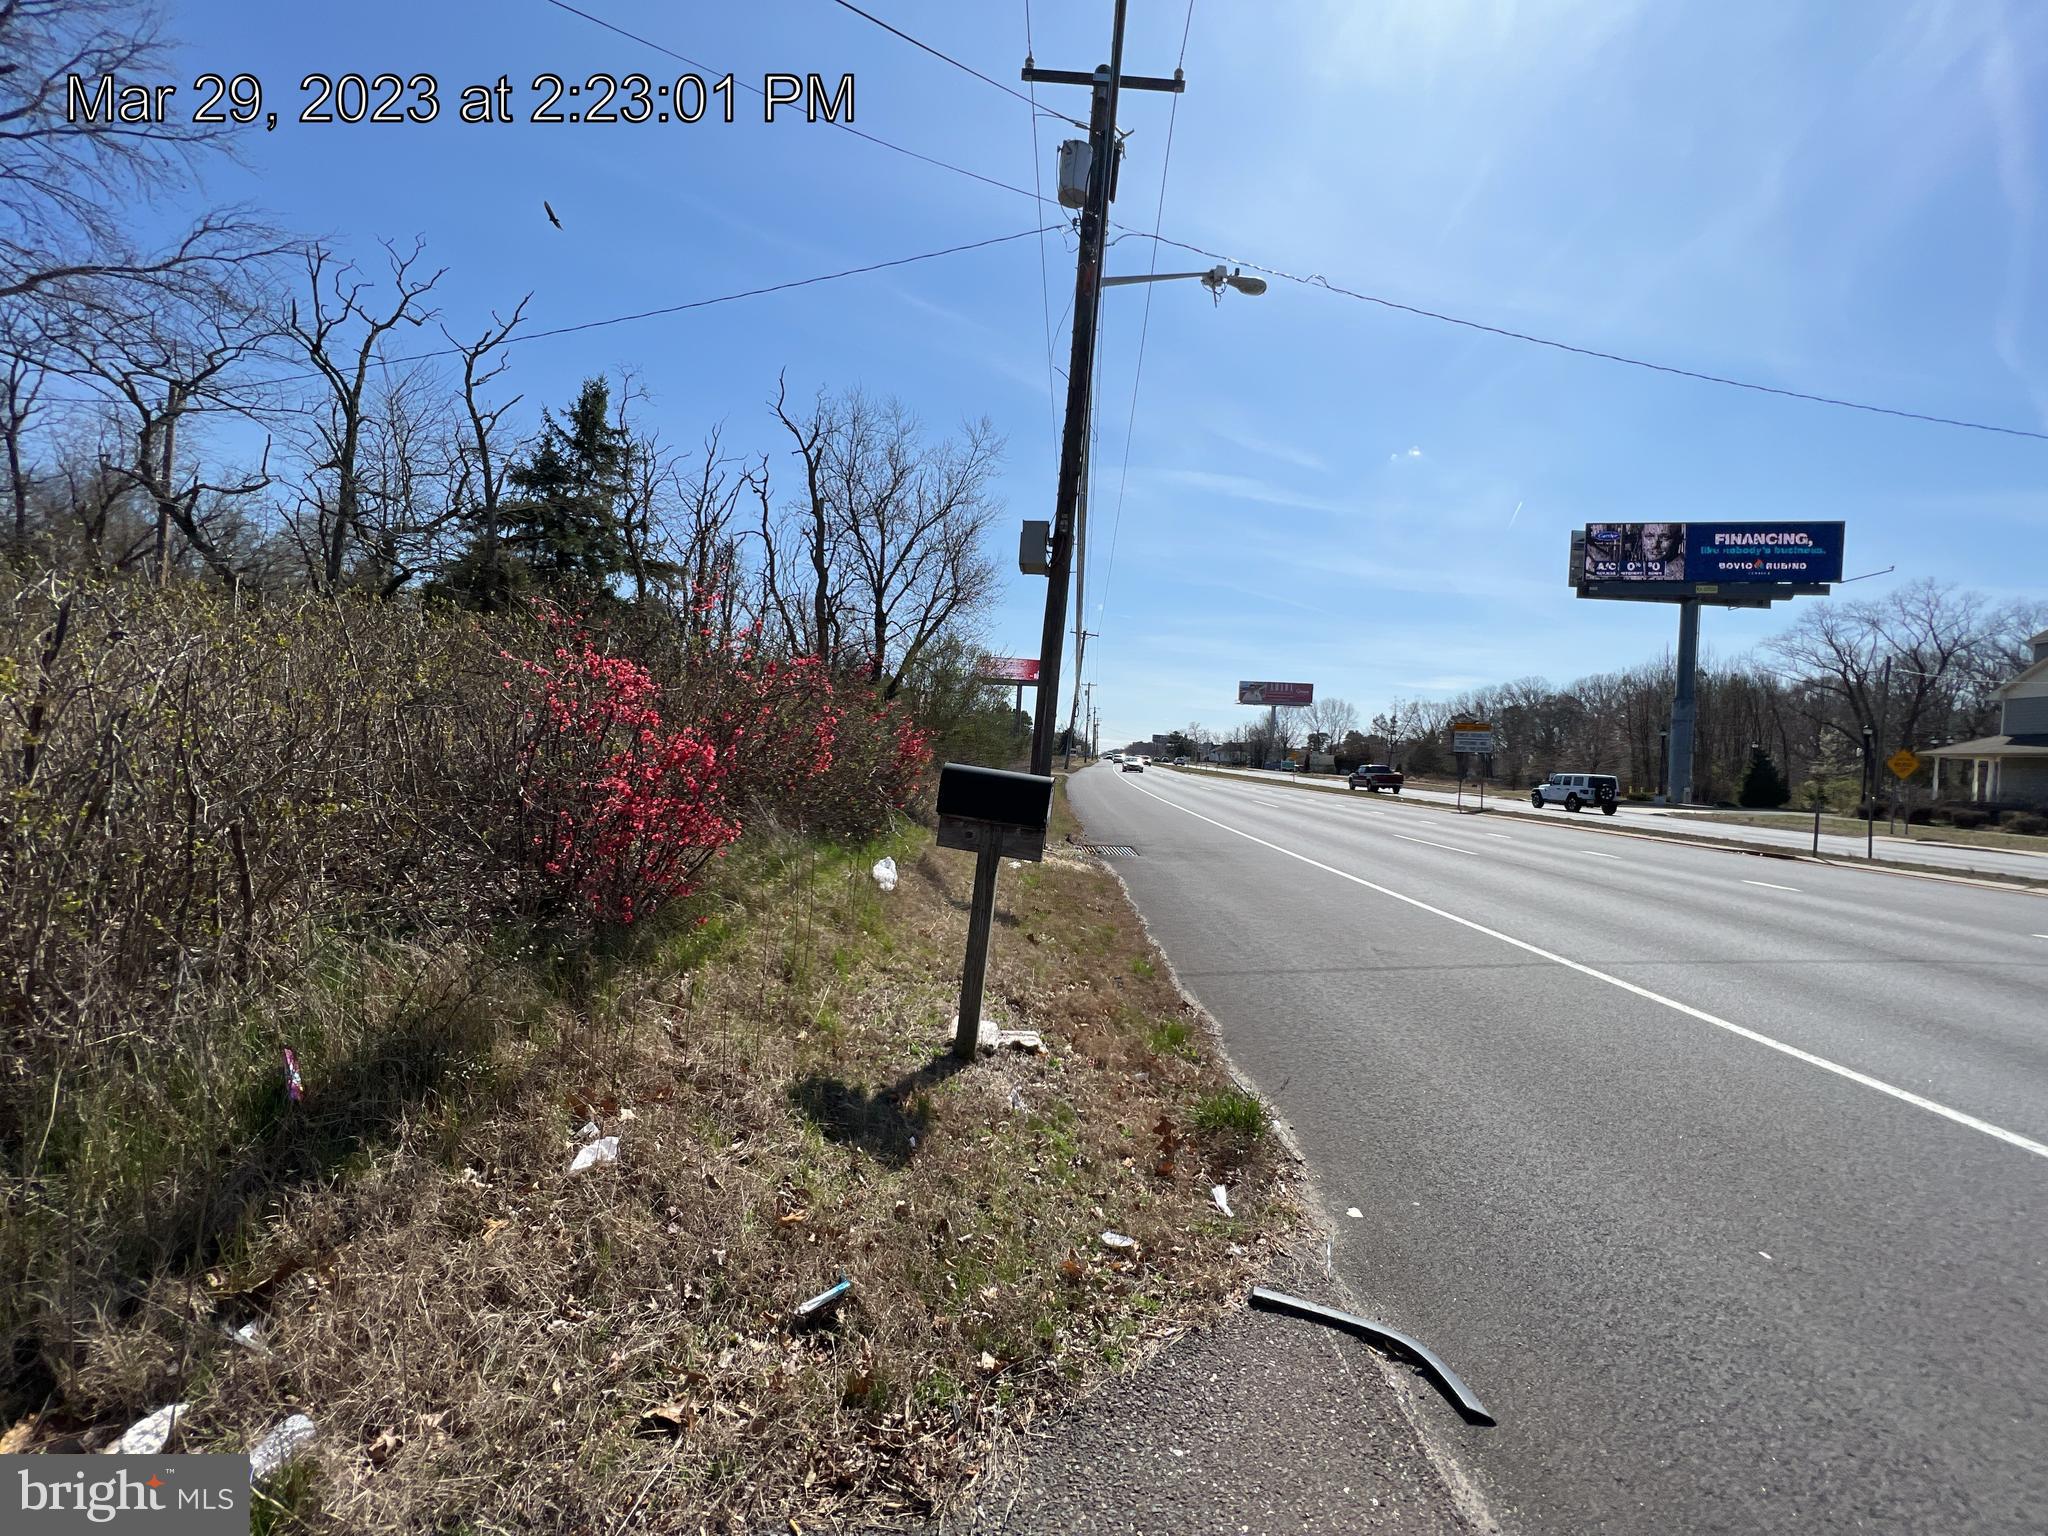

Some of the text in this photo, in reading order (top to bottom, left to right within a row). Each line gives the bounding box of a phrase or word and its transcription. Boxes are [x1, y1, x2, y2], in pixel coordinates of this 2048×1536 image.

[1714, 533, 1814, 547] FINANCING,
[1718, 562, 1807, 570] BOVIO RUBINO
